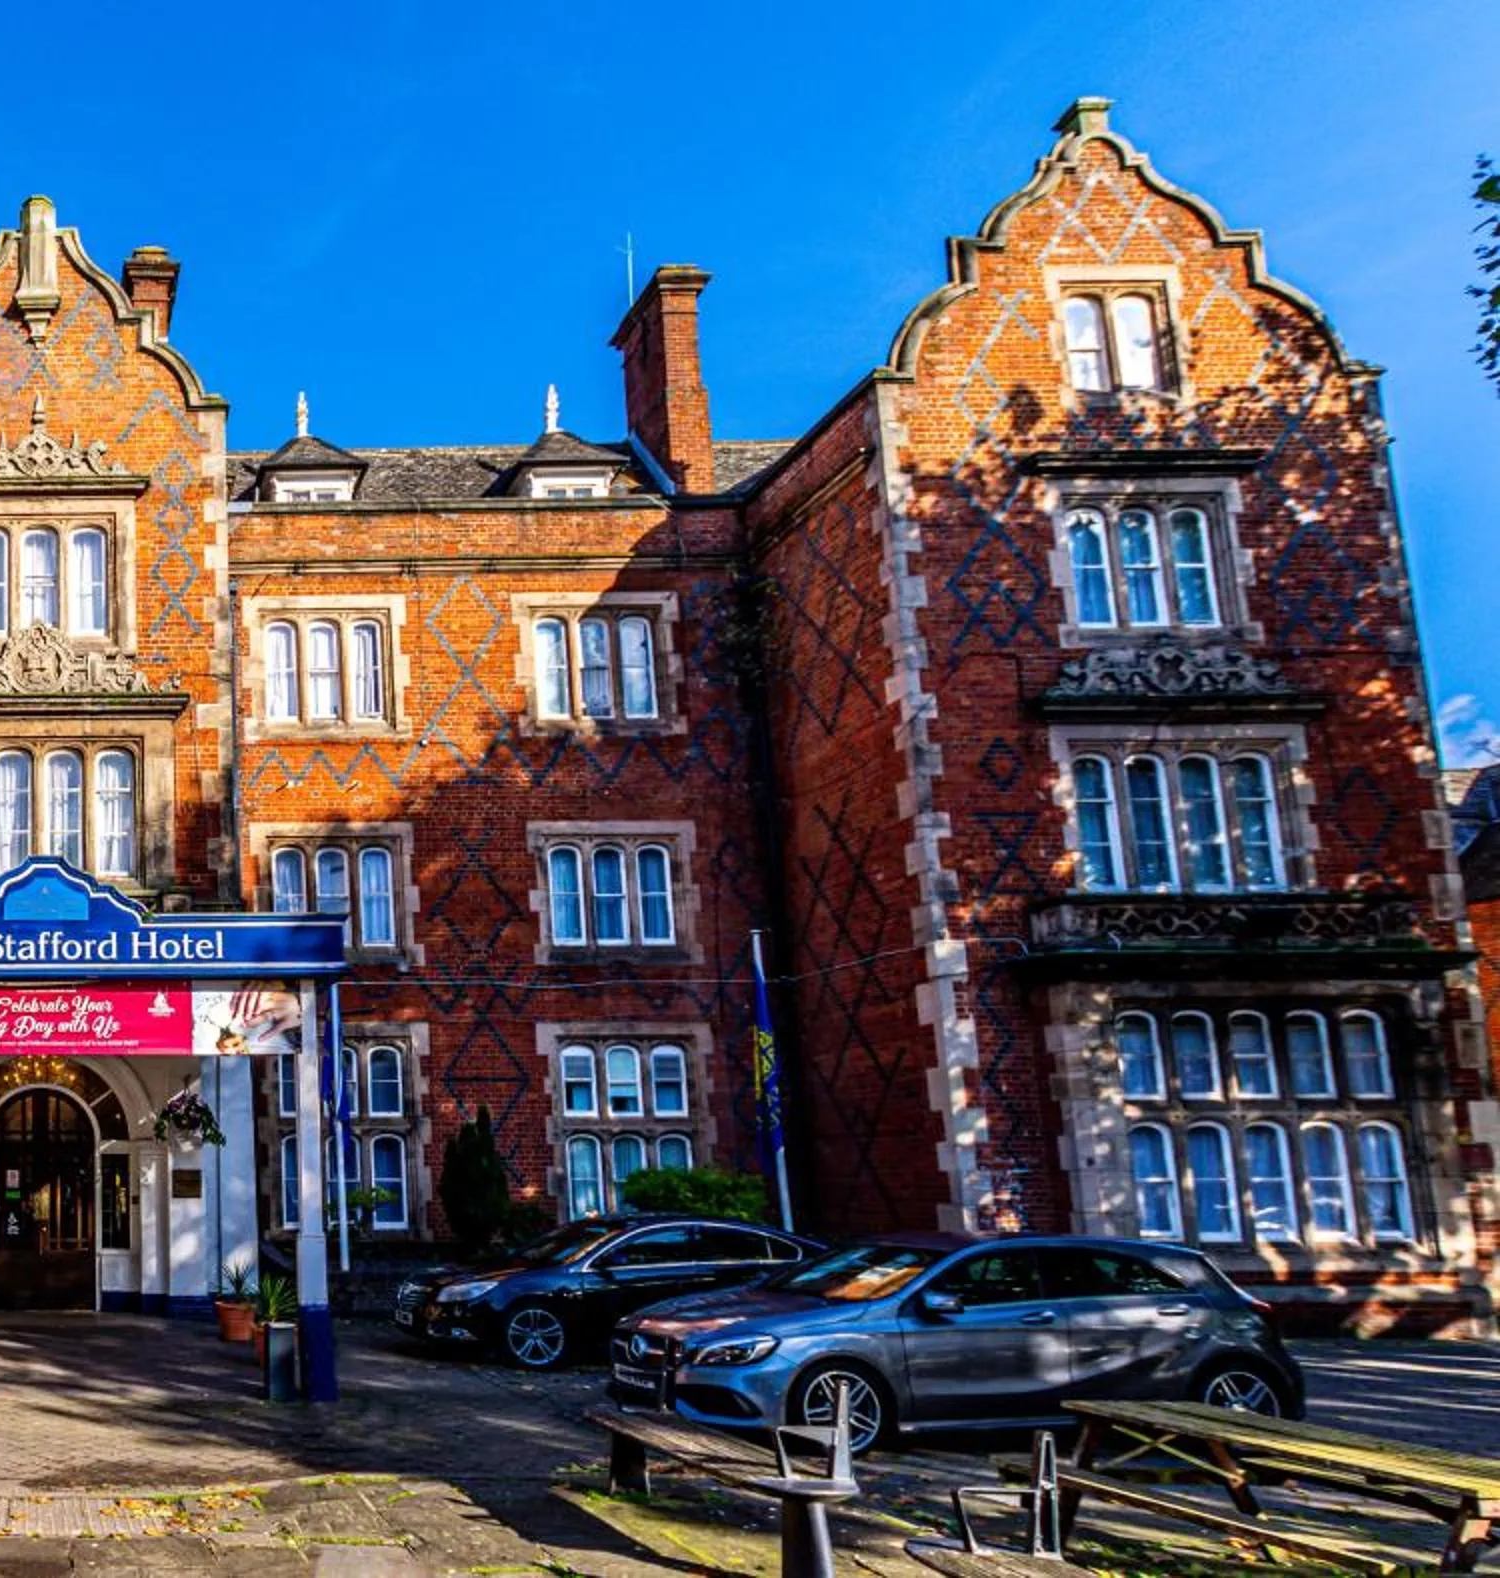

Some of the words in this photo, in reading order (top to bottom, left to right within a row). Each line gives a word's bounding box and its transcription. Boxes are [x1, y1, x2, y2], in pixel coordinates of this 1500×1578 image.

[131, 930, 224, 960] Hotel
[71, 995, 113, 1018] Your
[11, 1015, 55, 1038] Day
[57, 1015, 89, 1033] with
[91, 1015, 121, 1038] Us
